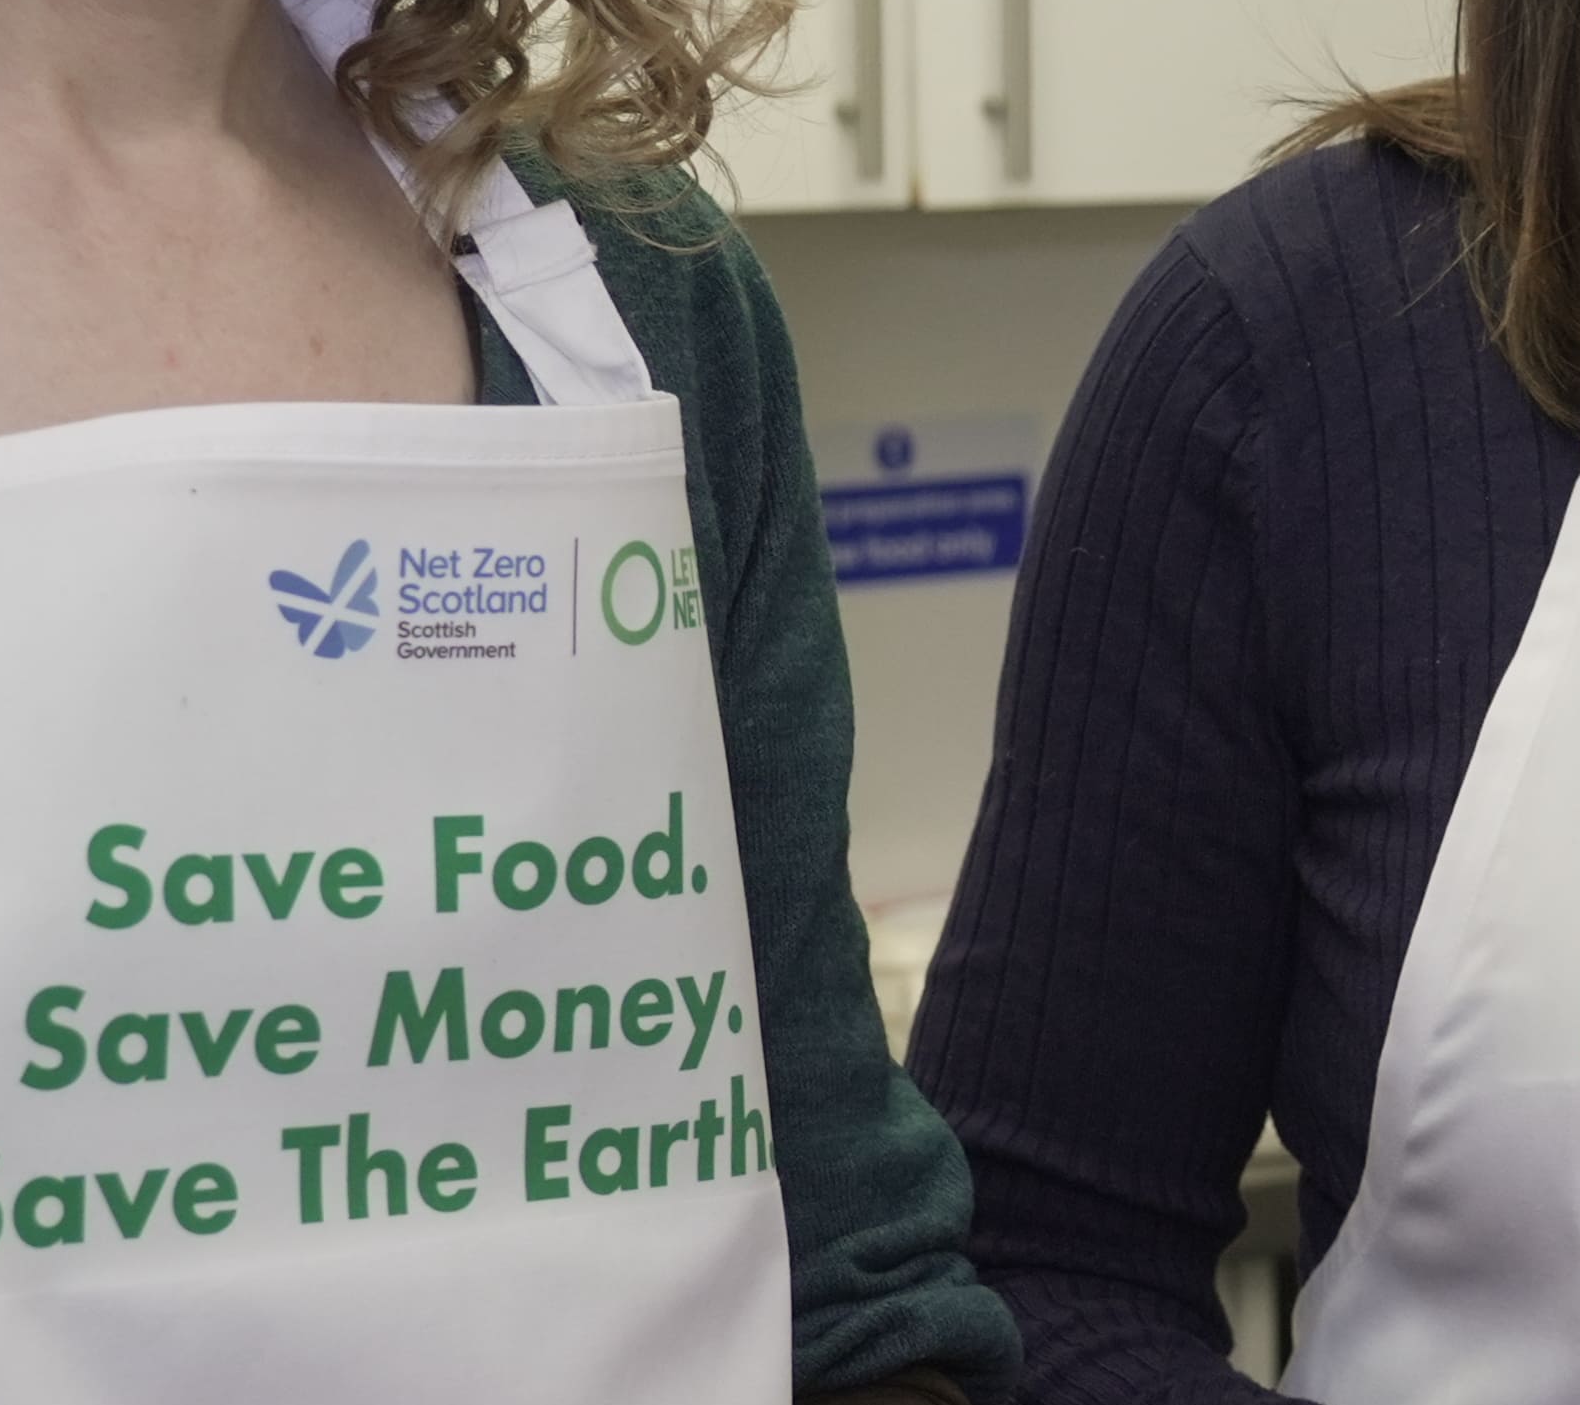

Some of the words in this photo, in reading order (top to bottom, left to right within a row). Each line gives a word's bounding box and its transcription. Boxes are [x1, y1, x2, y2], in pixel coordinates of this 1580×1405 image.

[399, 547, 461, 579] Net
[472, 547, 545, 579] Zero
[397, 582, 548, 615] Scotland
[396, 620, 477, 639] Scottish
[396, 640, 517, 661] Government
[84, 823, 385, 931] Save
[433, 791, 708, 913] Food.
[20, 985, 322, 1091] Save
[366, 967, 744, 1072] Money.
[281, 1112, 479, 1225] The
